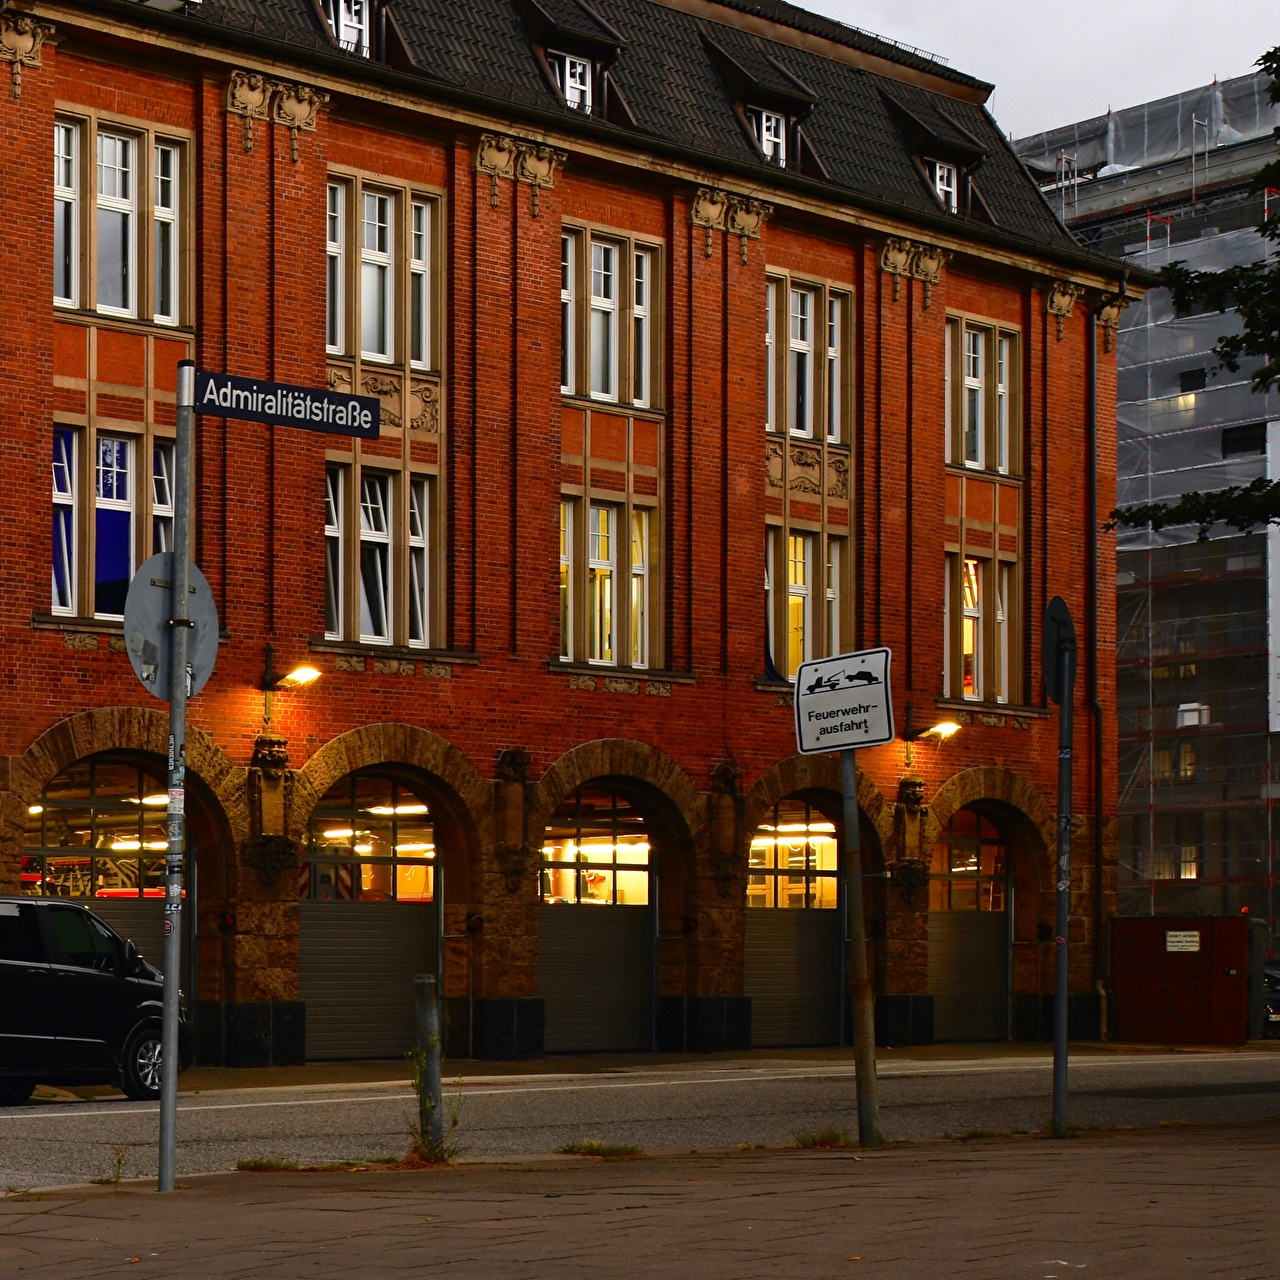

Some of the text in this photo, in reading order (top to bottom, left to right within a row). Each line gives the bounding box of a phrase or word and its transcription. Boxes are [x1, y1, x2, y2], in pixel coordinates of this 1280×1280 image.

[203, 378, 372, 429] Admiralitätstraße
[807, 703, 878, 722] Feuerwehr-
[819, 719, 868, 736] ausfahrt
